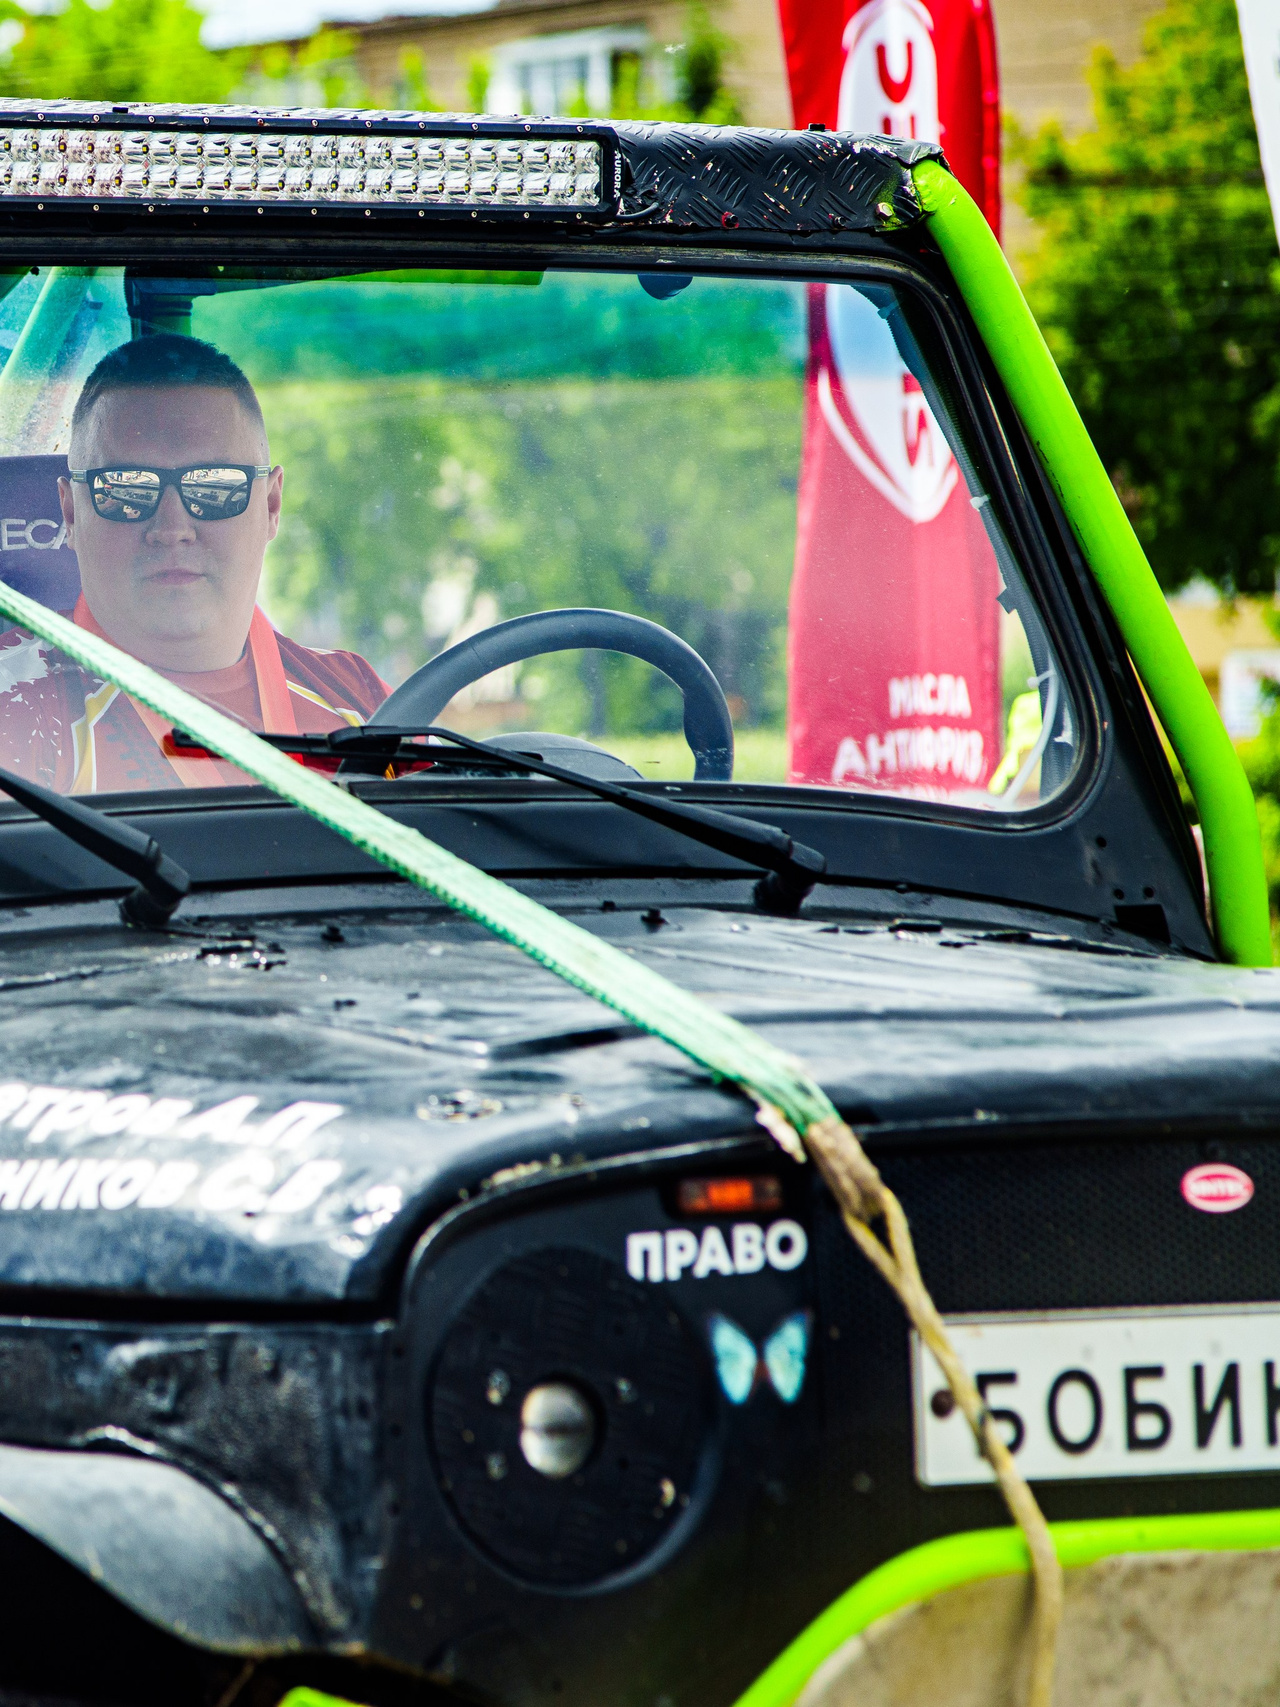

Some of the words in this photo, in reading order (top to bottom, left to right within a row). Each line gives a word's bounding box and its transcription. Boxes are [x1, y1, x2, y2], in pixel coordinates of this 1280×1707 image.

[613, 147, 622, 201] AURORA
[888, 673, 973, 719] МАСЛА
[626, 1218, 808, 1283] ПРАВО
